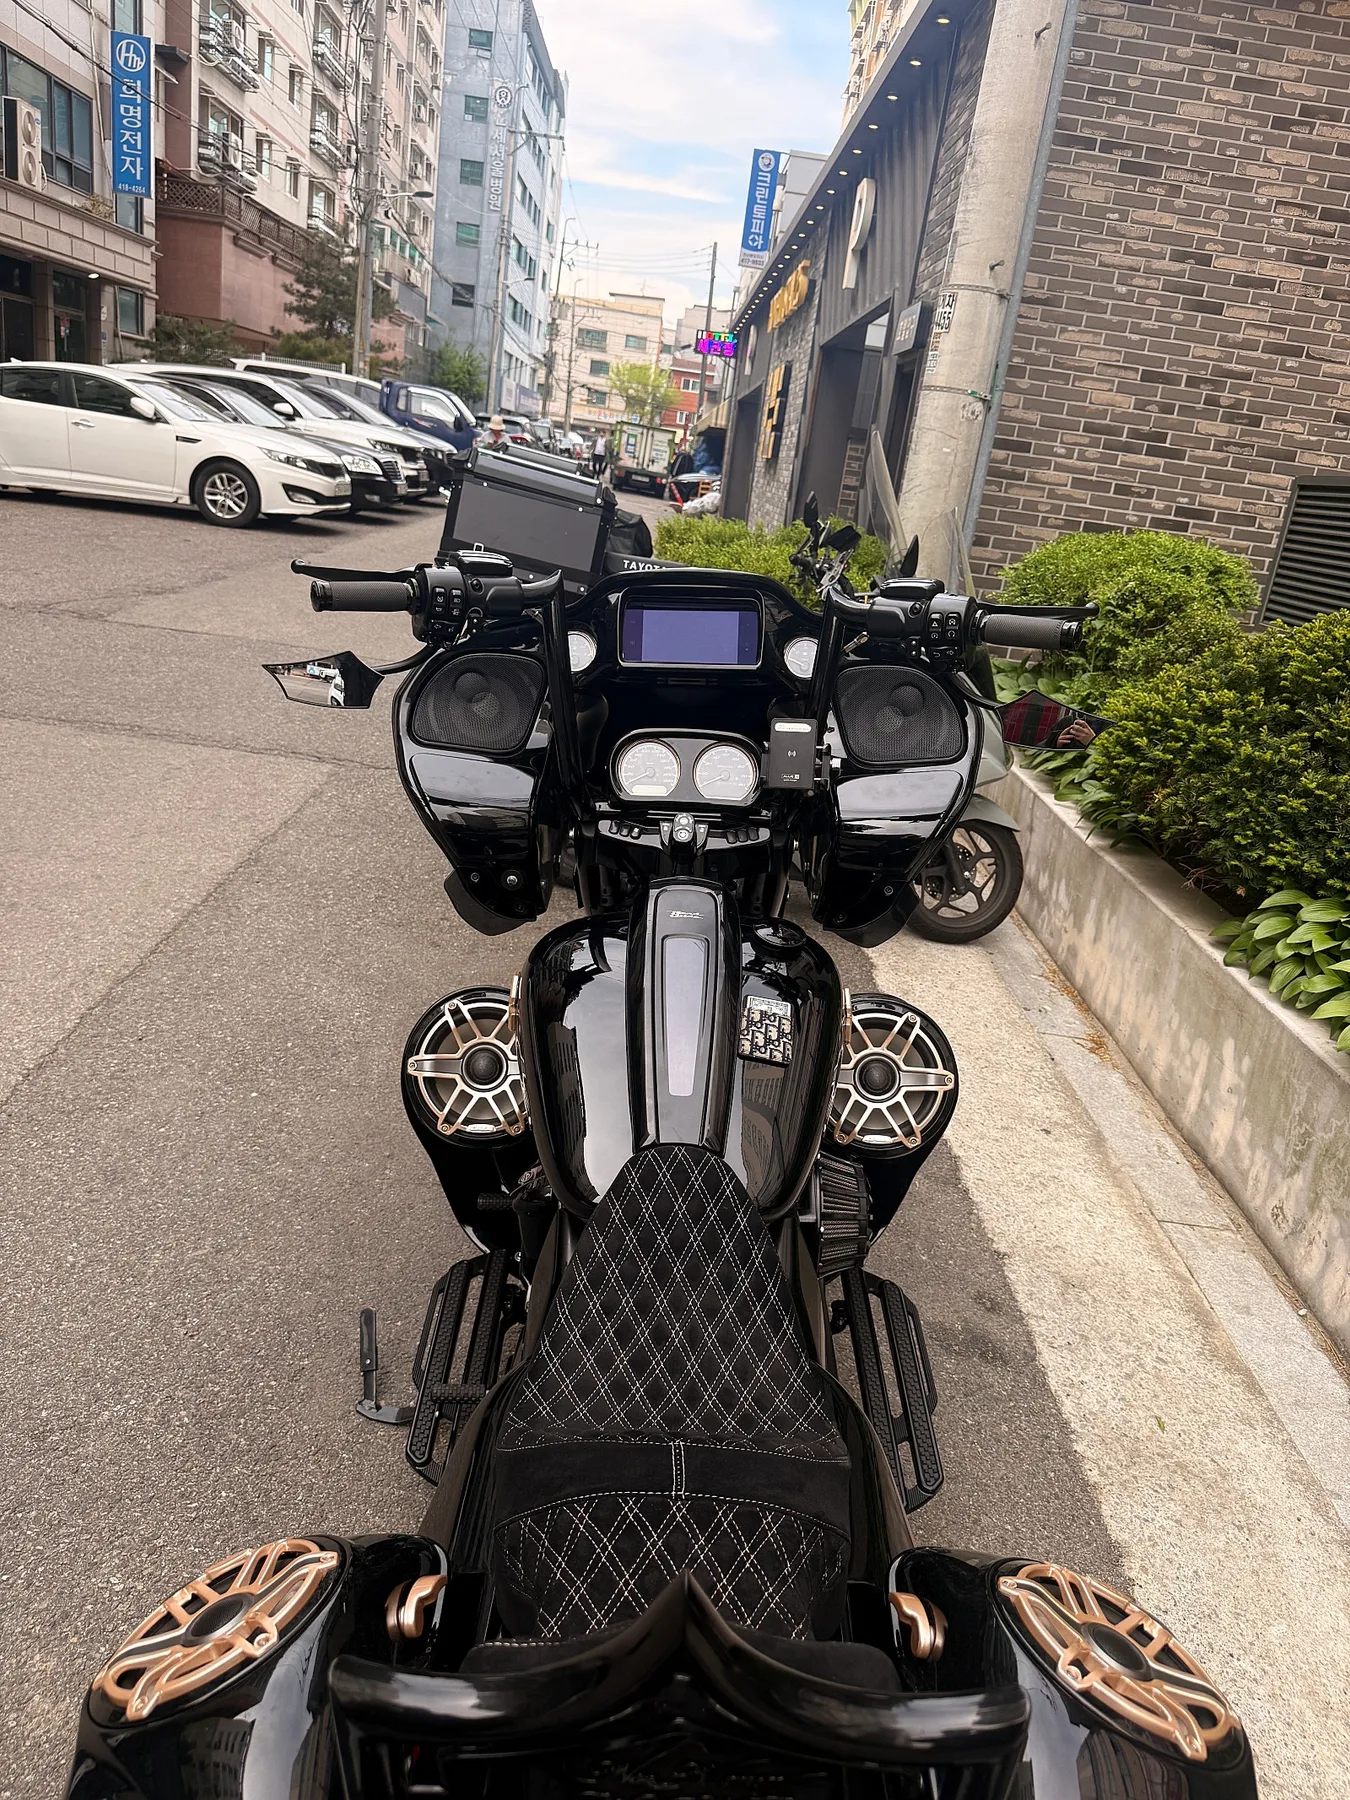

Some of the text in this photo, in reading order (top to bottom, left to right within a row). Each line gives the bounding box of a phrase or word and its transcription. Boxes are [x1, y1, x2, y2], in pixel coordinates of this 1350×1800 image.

[119, 78, 144, 182] 희명전자
[117, 182, 146, 195] 418-4264
[747, 171, 771, 250] 크린토피아
[623, 559, 666, 571] TAYOT
